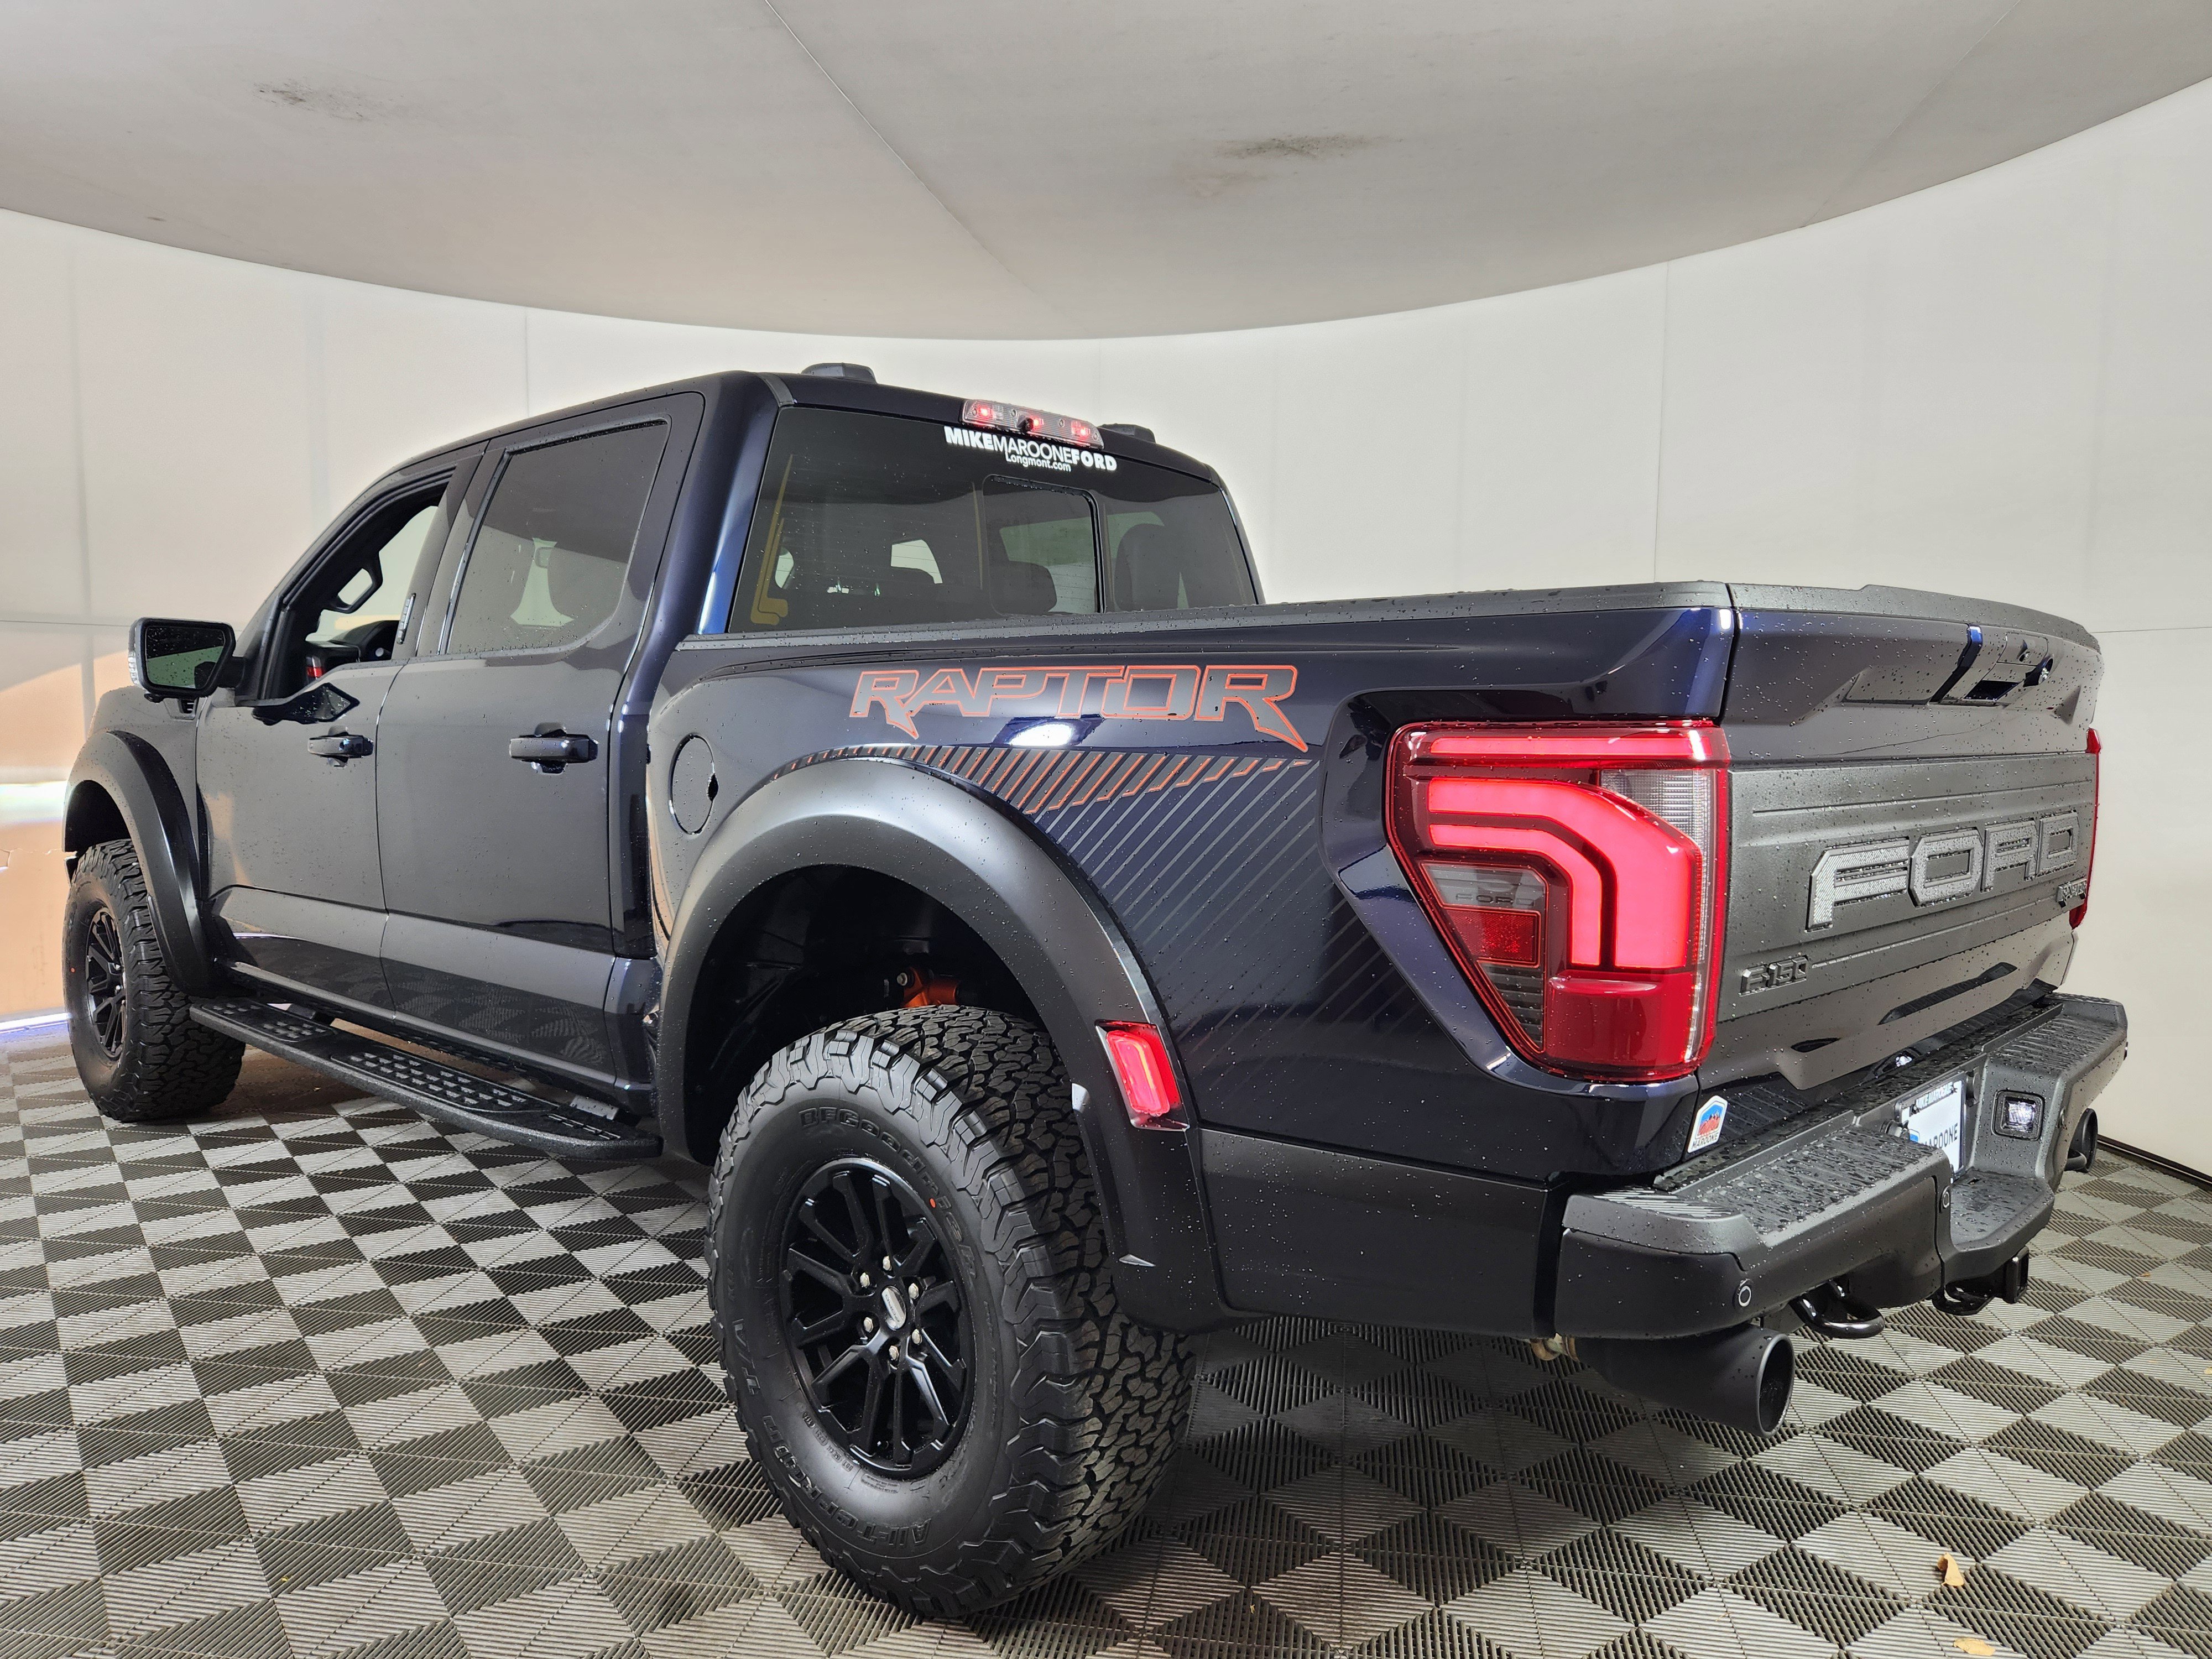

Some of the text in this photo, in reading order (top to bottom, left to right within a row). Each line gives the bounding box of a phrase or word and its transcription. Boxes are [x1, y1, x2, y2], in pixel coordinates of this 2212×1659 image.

[1006, 452, 1072, 472] Longmont.com
[850, 665, 1309, 753] RAPTOR
[1806, 810, 2080, 933] FORD
[1455, 894, 1534, 906] FORD
[1692, 1132, 1718, 1148] MAROONE
